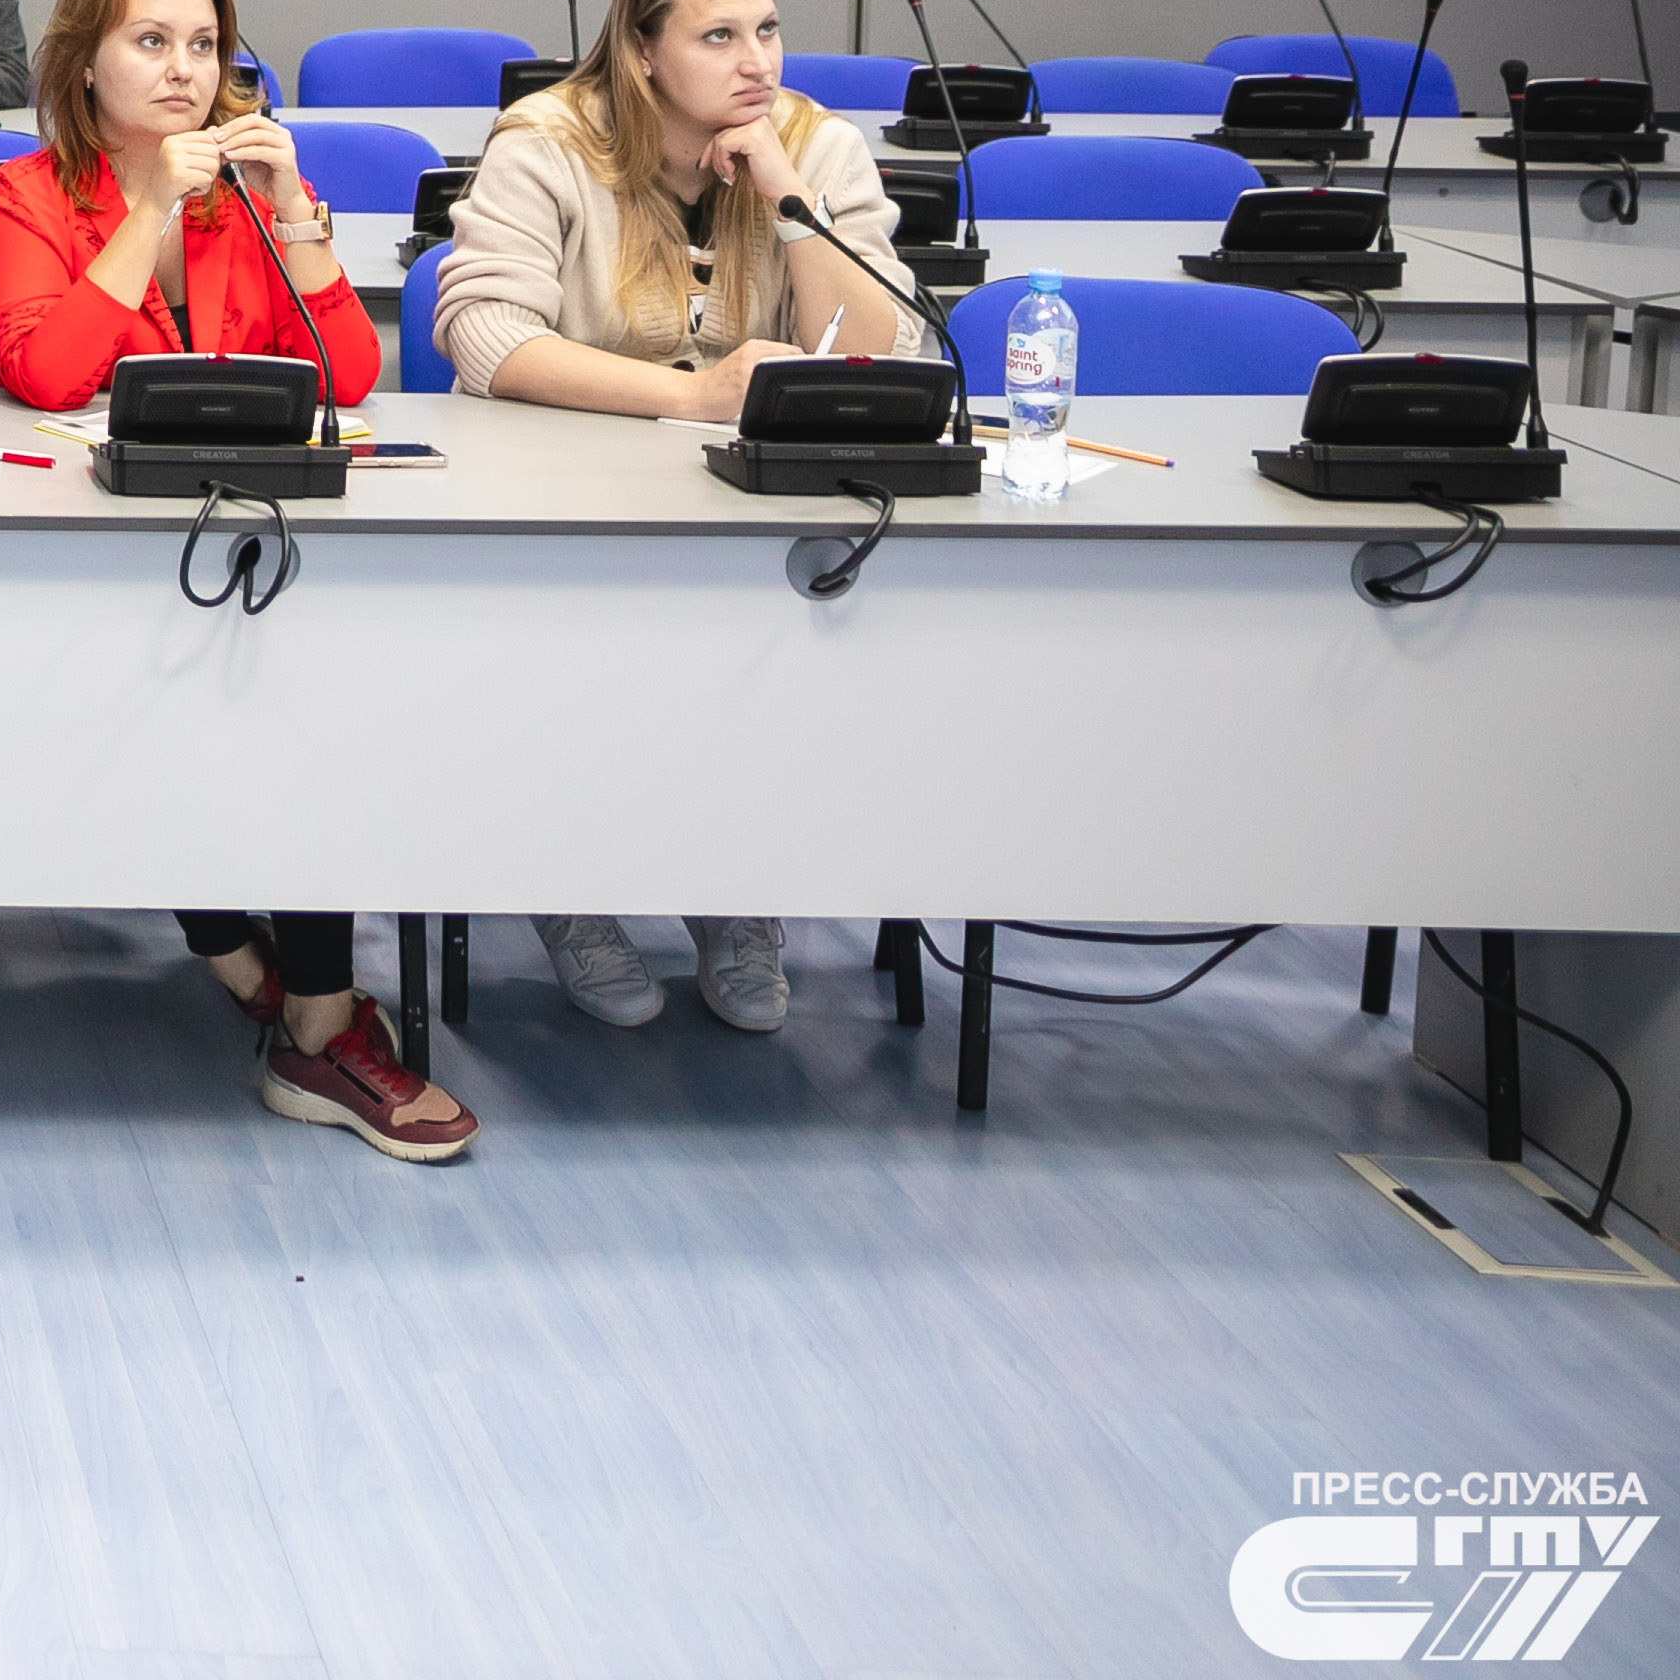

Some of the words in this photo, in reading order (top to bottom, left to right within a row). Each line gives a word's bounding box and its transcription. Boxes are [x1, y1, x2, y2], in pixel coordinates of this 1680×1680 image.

[192, 450, 238, 460] CREATOR
[830, 449, 876, 458] CREATOR
[1403, 451, 1450, 460] CREATOR
